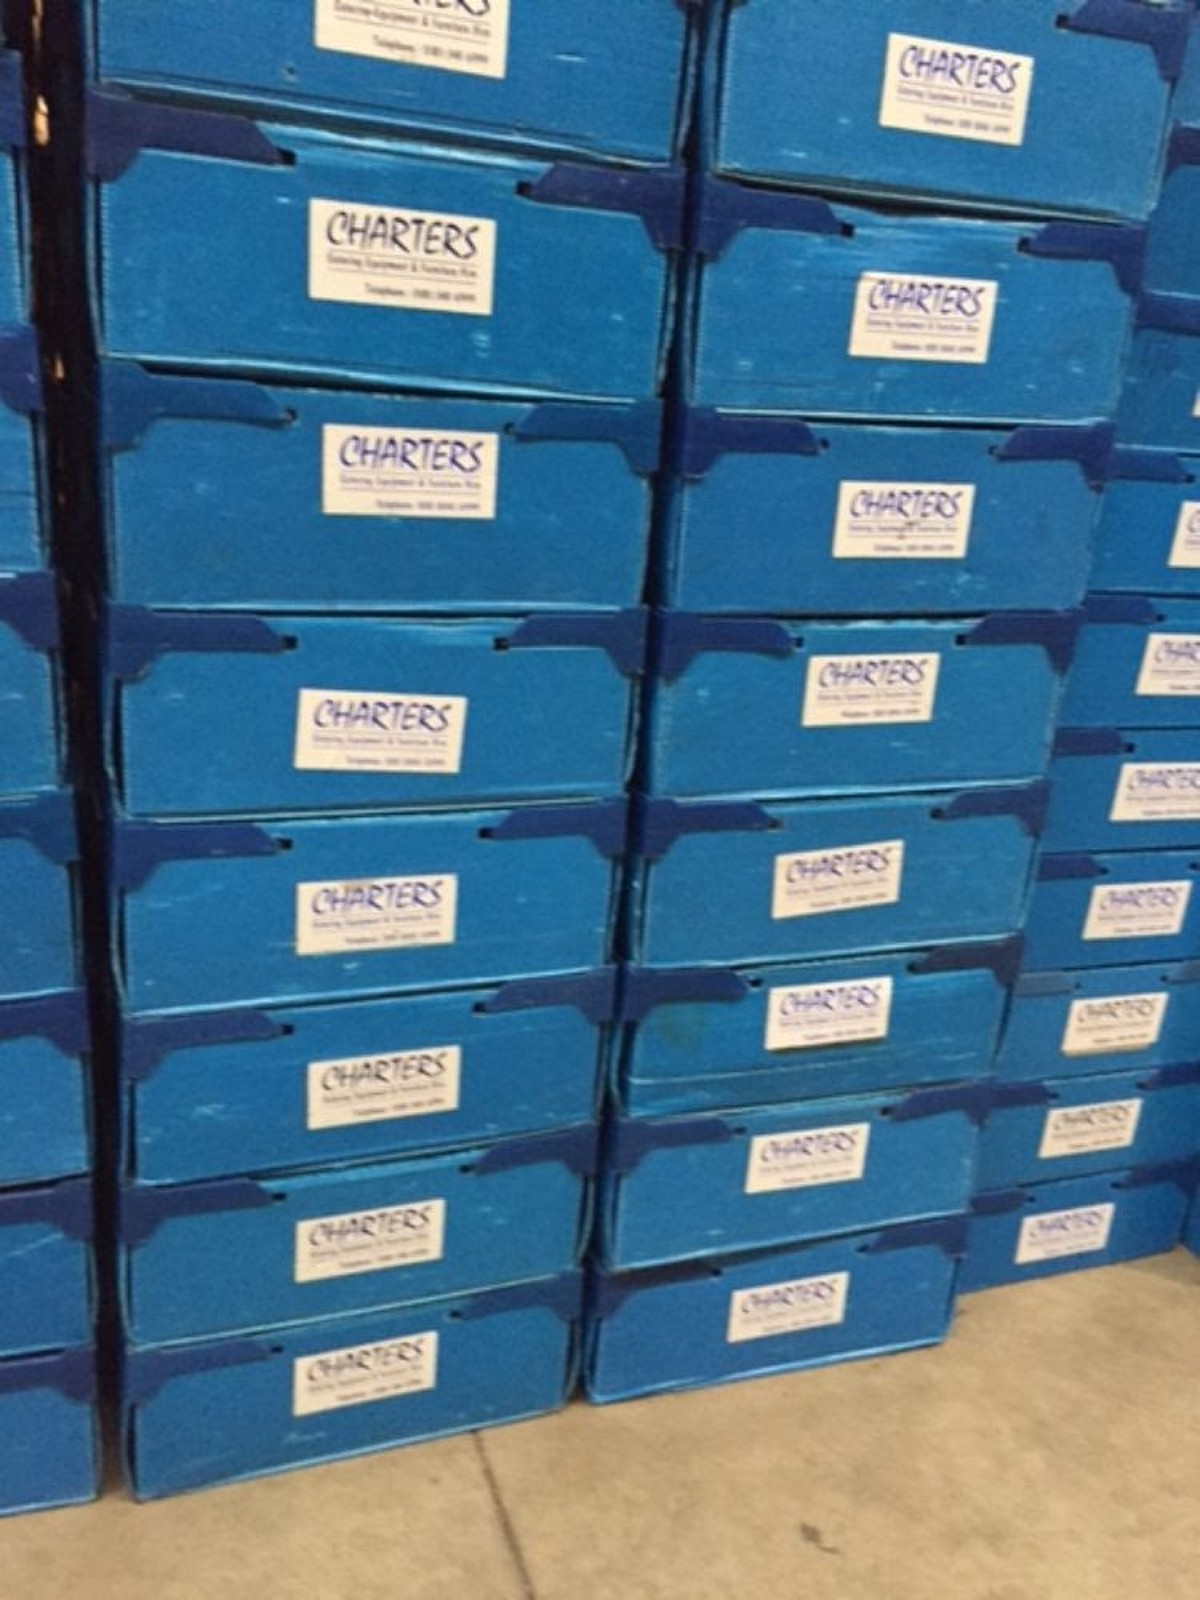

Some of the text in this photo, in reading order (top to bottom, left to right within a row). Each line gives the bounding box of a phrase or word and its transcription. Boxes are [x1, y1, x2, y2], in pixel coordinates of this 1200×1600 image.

[900, 45, 1020, 93] CHARTERS
[327, 211, 479, 259] CHARTERS
[869, 279, 985, 317] CHARTERS
[340, 435, 484, 473] CHARTERS
[850, 489, 963, 518] CHARTERS
[819, 659, 928, 687] CHARTERS
[314, 699, 452, 732] CHARTERS
[786, 847, 892, 883] CHARTERS
[312, 880, 443, 914] CHARTERS
[1100, 885, 1183, 910] CHARTERS
[780, 983, 882, 1015] CHARTERS
[322, 1051, 447, 1090] CHARTERS
[760, 1130, 858, 1162] CHARTERS
[309, 1205, 431, 1246] CHARTERS
[741, 1278, 838, 1313] CHARTERS
[307, 1338, 423, 1381] CHARTERS
